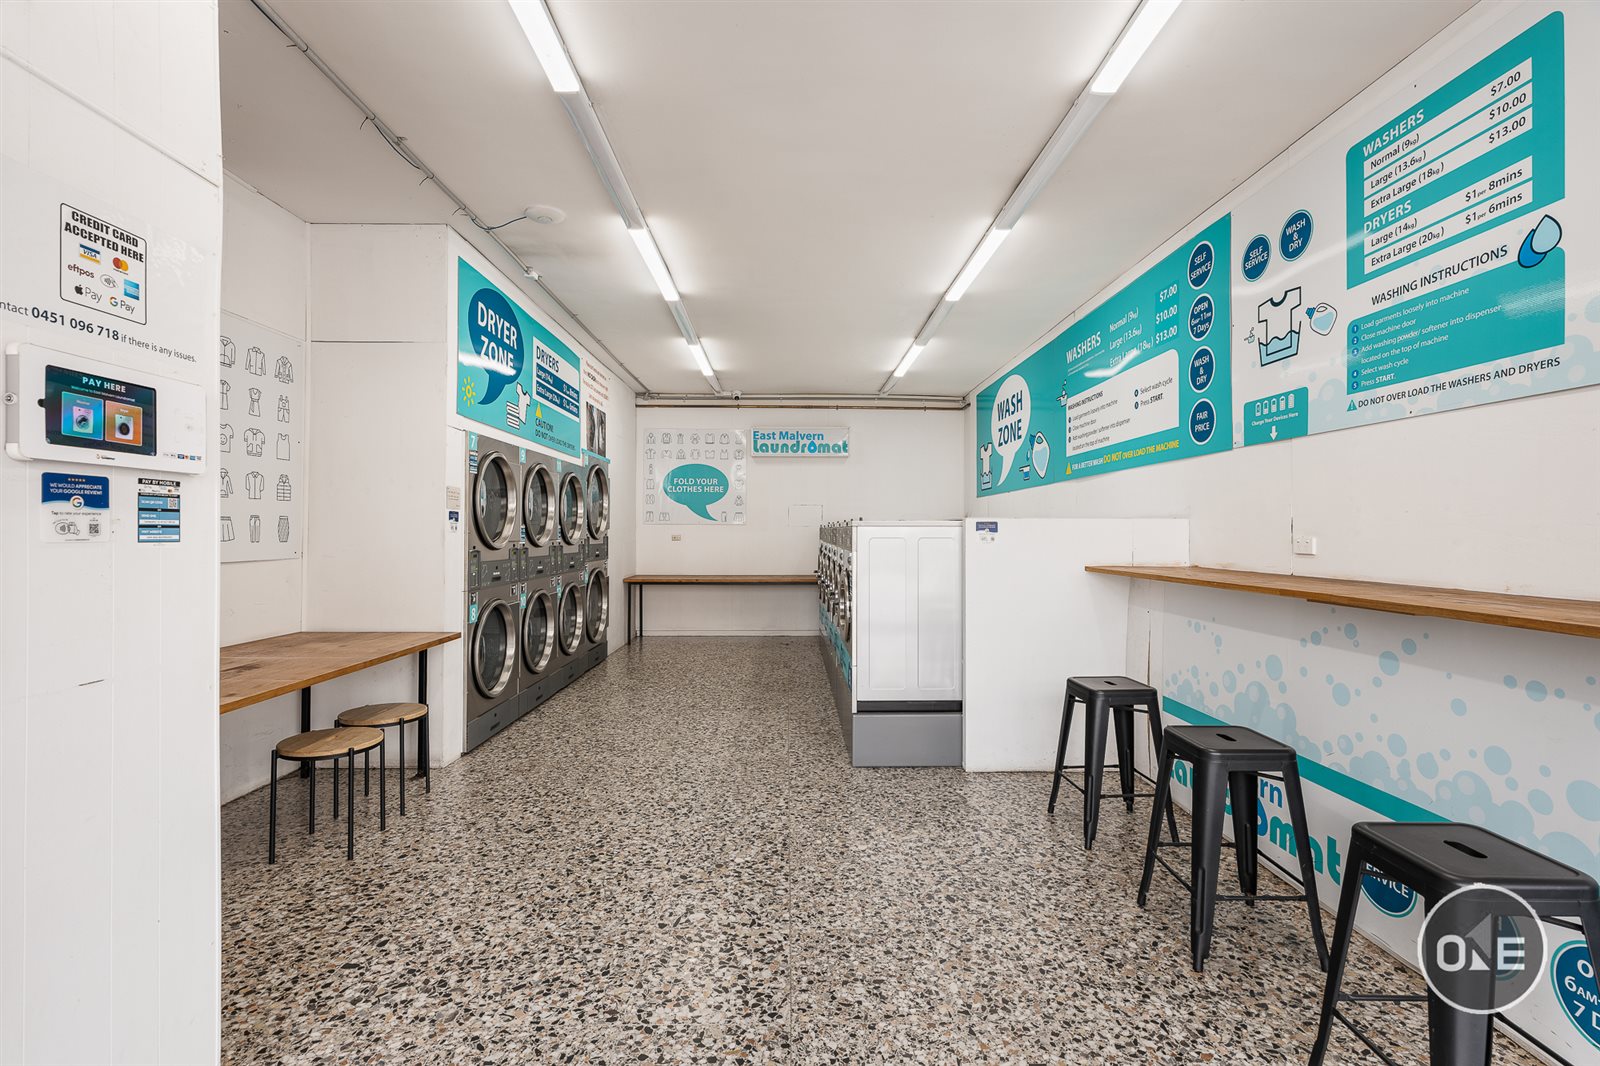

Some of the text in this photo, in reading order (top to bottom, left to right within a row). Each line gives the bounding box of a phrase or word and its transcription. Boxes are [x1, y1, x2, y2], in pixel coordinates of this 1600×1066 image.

[1370, 71, 1521, 170] Normal (9kg) $7.00
[1362, 108, 1424, 158] WASHERS
[1370, 92, 1527, 189] Large (13.6kg) $10.00
[1370, 116, 1526, 209] Extra Large (18kg) $13.00
[1363, 200, 1412, 234] DRYERS
[1370, 230, 1394, 248] Large
[1394, 218, 1418, 237] (14kg)
[1488, 168, 1523, 191] 8mins
[72, 211, 138, 247] CREDIT CARD
[1285, 218, 1306, 236] WASH
[1292, 232, 1298, 241] &
[1370, 251, 1392, 267] Extra
[1392, 238, 1417, 258] Large
[1418, 226, 1445, 246] (20kg)
[1488, 192, 1523, 214] 6mins
[64, 222, 144, 263] ACCEPTED HERE
[1288, 238, 1303, 252] DRY
[83, 249, 97, 259] VISA
[1194, 252, 1207, 266] SELF
[1244, 252, 1269, 270] SERVICE
[1249, 246, 1263, 260] SELF
[67, 264, 95, 278] eftpos
[1190, 261, 1211, 280] SERVICE
[1370, 244, 1508, 306] WASHING INSTRUCTIONS
[85, 287, 102, 303] Pay
[1159, 284, 1178, 302] $7.00
[120, 300, 135, 314] Pay
[1156, 304, 1178, 325] $10.00
[1194, 301, 1208, 314] OPEN
[1361, 287, 1470, 330] Load garments loosely into machine
[477, 301, 518, 351] DRYER
[1110, 314, 1127, 333] Normal
[1361, 344, 1372, 352] Add
[1373, 337, 1396, 351] washing
[1421, 321, 1448, 334] softener
[1449, 315, 1464, 325] into
[1465, 304, 1502, 322] dispenser
[1361, 318, 1416, 341] Close machine door
[31, 307, 65, 326] 0451
[70, 318, 94, 334] 096
[97, 326, 119, 341] 718
[121, 334, 127, 343] if
[128, 337, 150, 350] there
[151, 343, 158, 352] is
[159, 346, 172, 357] any
[174, 348, 197, 362] issues.
[480, 335, 514, 368] ZONE
[1066, 331, 1101, 364] WASHERS
[1110, 337, 1122, 350] Large
[1156, 325, 1178, 344] $13.00
[1361, 353, 1381, 364] located
[1390, 348, 1400, 356] the
[1401, 344, 1412, 353] top
[1413, 340, 1420, 349] of
[1421, 334, 1449, 347] machine
[536, 345, 559, 372] DRYERS
[1193, 354, 1210, 367] WASH
[1361, 358, 1408, 376] Select wash cycle
[1196, 374, 1207, 385] DRY
[1200, 367, 1204, 375] &
[82, 376, 126, 393] PAY HERE
[1358, 356, 1561, 408] DO NOT OVER LOAD THE WASHERS AND DRYERS
[1361, 379, 1374, 387] Press
[997, 390, 1023, 422] WASH
[1196, 410, 1208, 422] FAIR
[753, 430, 824, 441] East Malvern
[998, 418, 1022, 447] ZONE
[1194, 422, 1210, 432] PRICE
[471, 434, 476, 448] 7
[753, 440, 848, 454] Laundromat
[1103, 454, 1111, 464] DO
[1111, 452, 1122, 462] NOT
[1146, 446, 1155, 454] THE
[1155, 440, 1179, 452] MACHINE
[667, 485, 702, 493] CLOTHES
[471, 608, 476, 620] 8
[1366, 863, 1409, 898] ERVICE
[1573, 1000, 1586, 1017] 7
